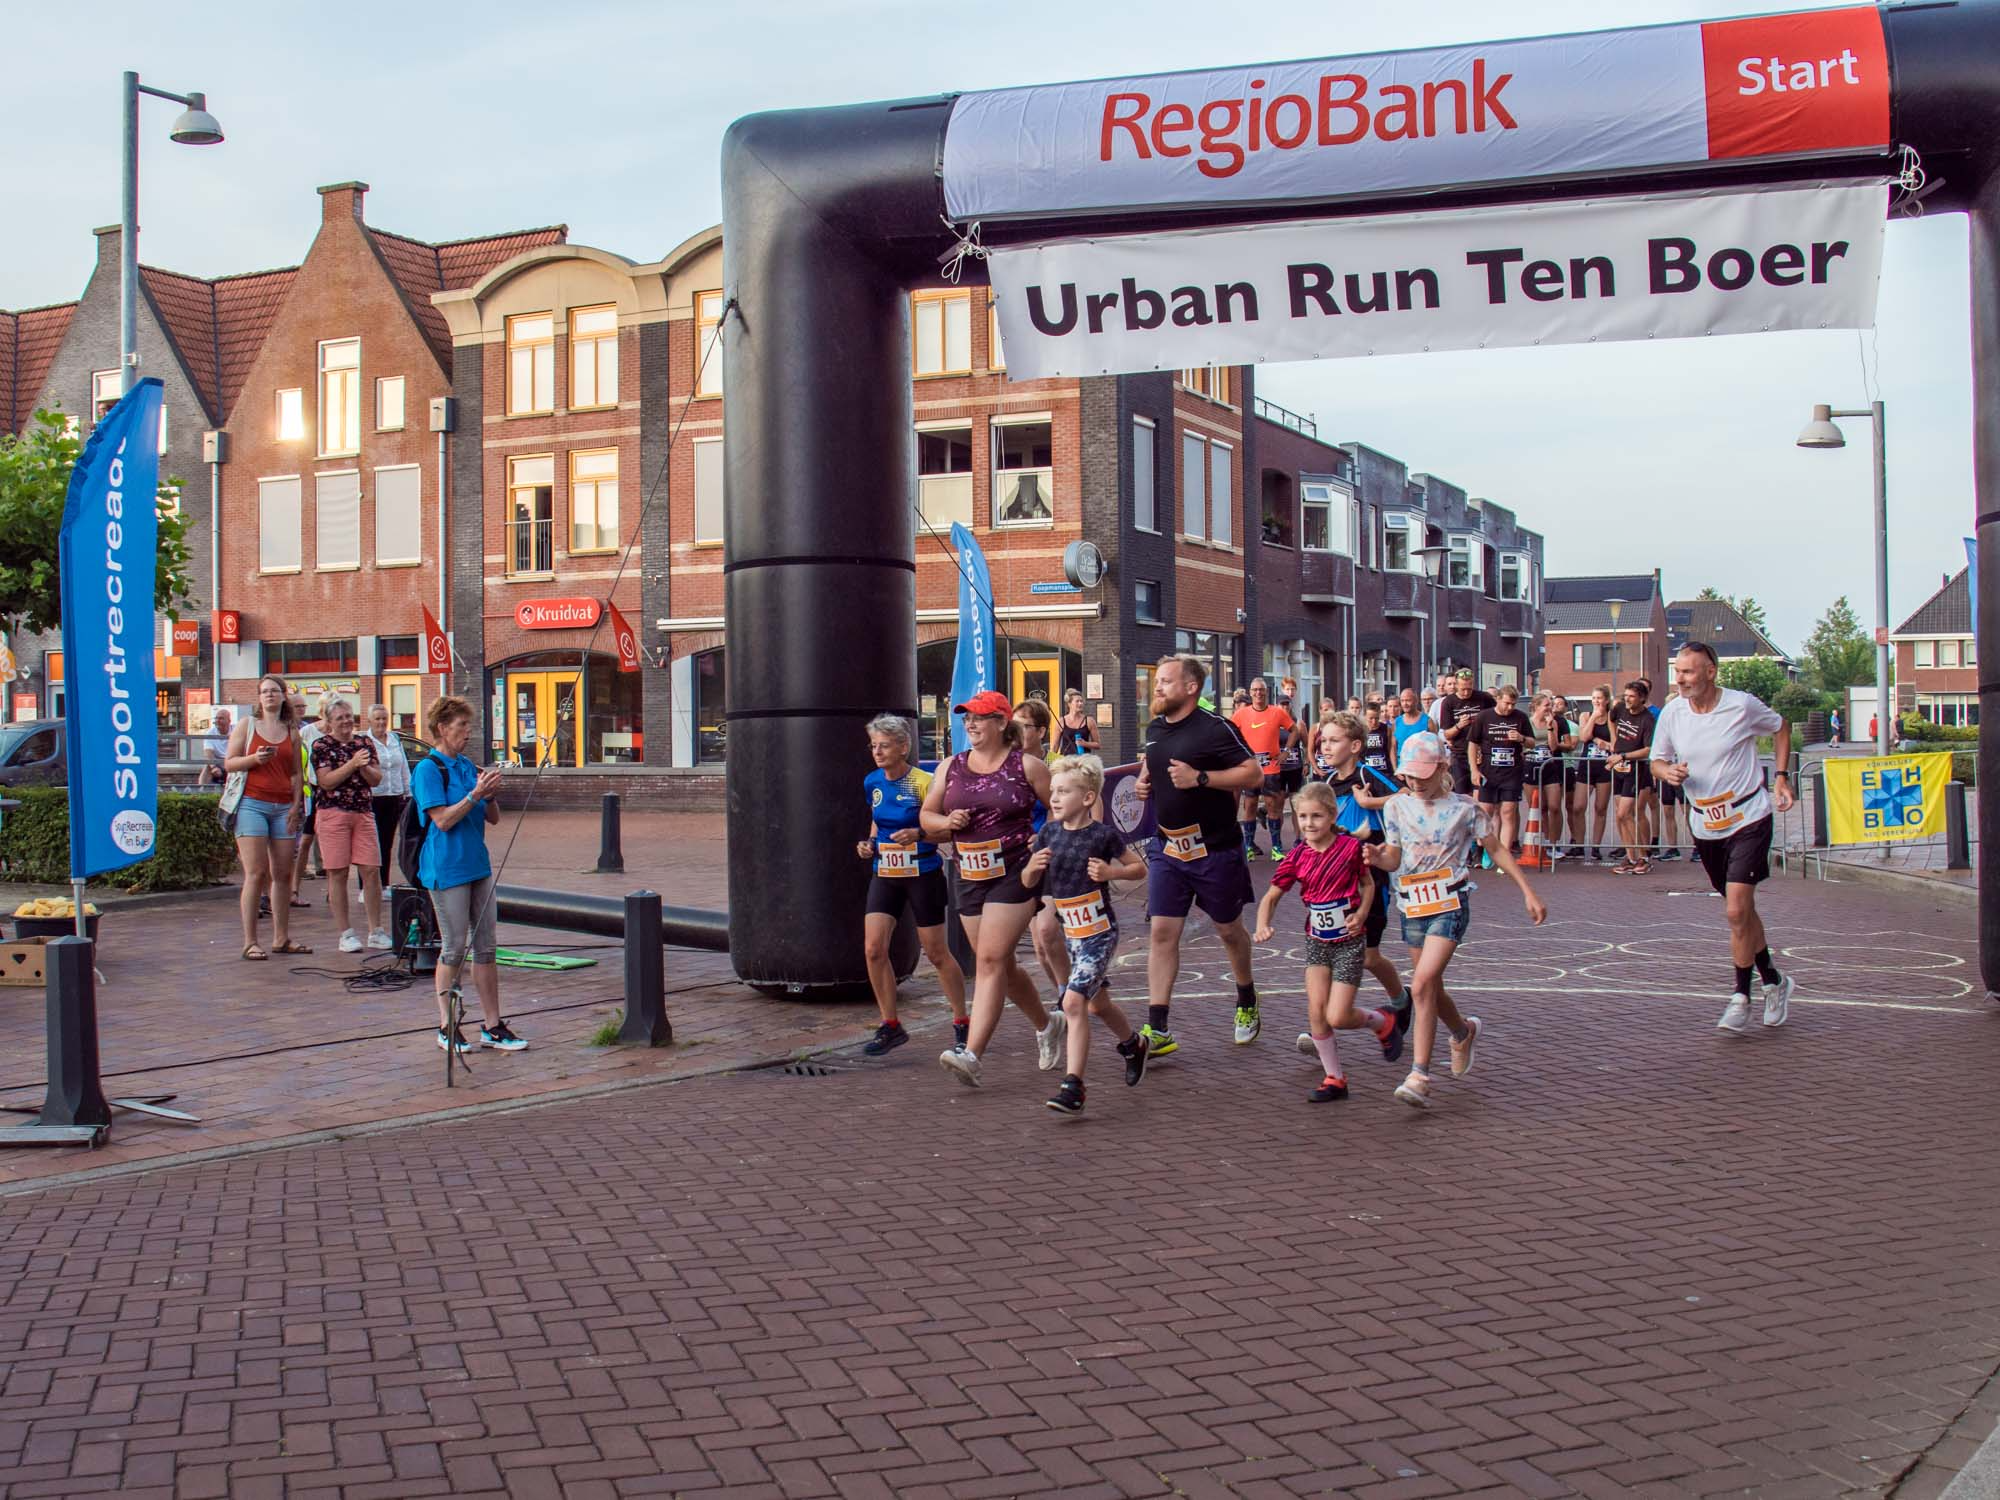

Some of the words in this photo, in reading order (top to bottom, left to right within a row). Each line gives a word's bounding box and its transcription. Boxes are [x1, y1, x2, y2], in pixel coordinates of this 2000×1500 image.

[1738, 49, 1860, 97] Start
[1100, 58, 1518, 178] RegioBank
[1026, 277, 1259, 337] Urban
[1287, 262, 1440, 318] Run
[1466, 247, 1616, 305] Ten
[1648, 236, 1850, 295] Boer
[537, 604, 593, 622] Kruidvat
[174, 630, 198, 644] coop
[1861, 771, 1876, 786] E
[1905, 766, 1921, 782] H
[1706, 803, 1727, 821] 107
[1864, 813, 1879, 828] B
[1906, 808, 1924, 825] O
[886, 853, 904, 867] 101
[967, 853, 990, 869] 115
[1413, 882, 1440, 904] 111
[1067, 906, 1093, 926] 114
[1316, 911, 1335, 928] 35
